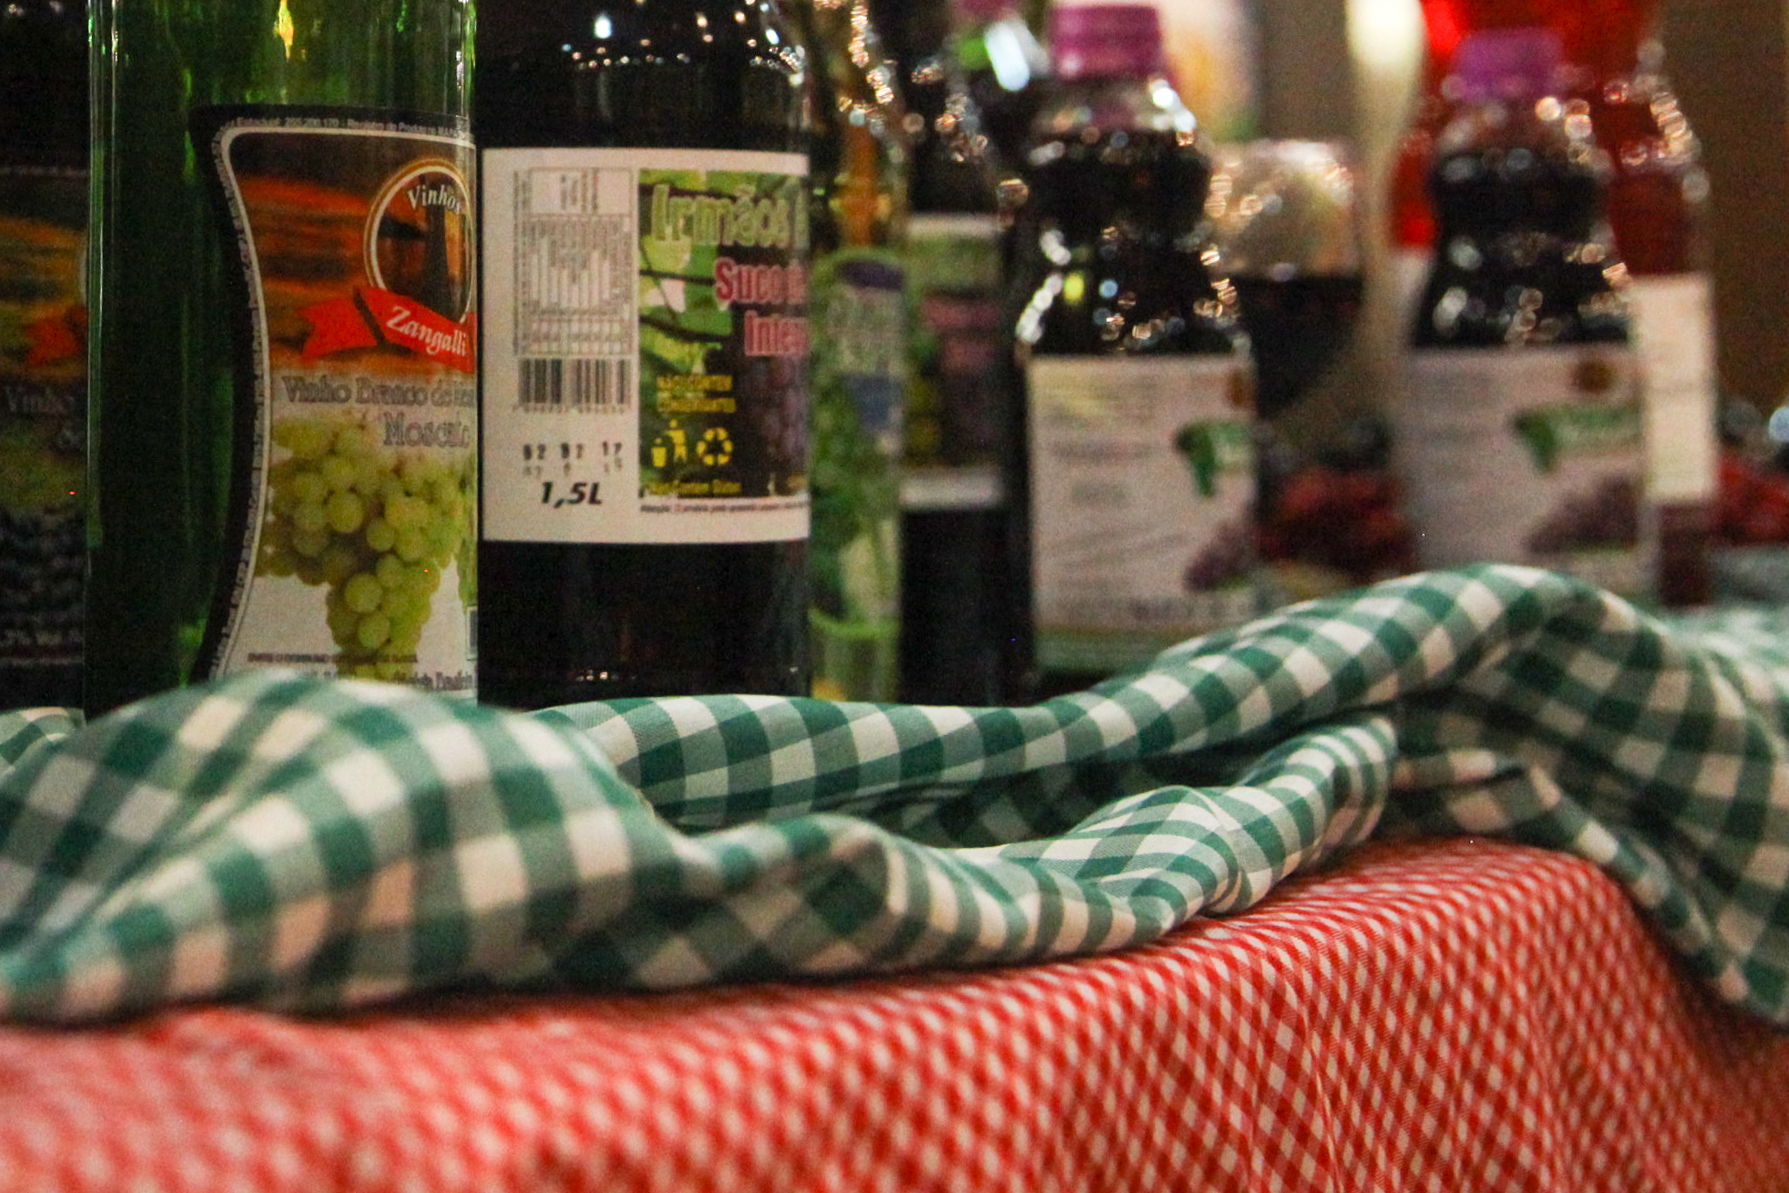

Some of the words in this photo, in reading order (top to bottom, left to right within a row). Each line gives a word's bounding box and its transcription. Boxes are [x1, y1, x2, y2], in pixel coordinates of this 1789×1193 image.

[651, 183, 790, 248] Irmãos
[714, 256, 784, 306] Suco
[386, 305, 468, 357] Zangalli
[281, 374, 352, 403] Vinho
[356, 377, 428, 406] Branco
[541, 481, 603, 509] 1,5L
